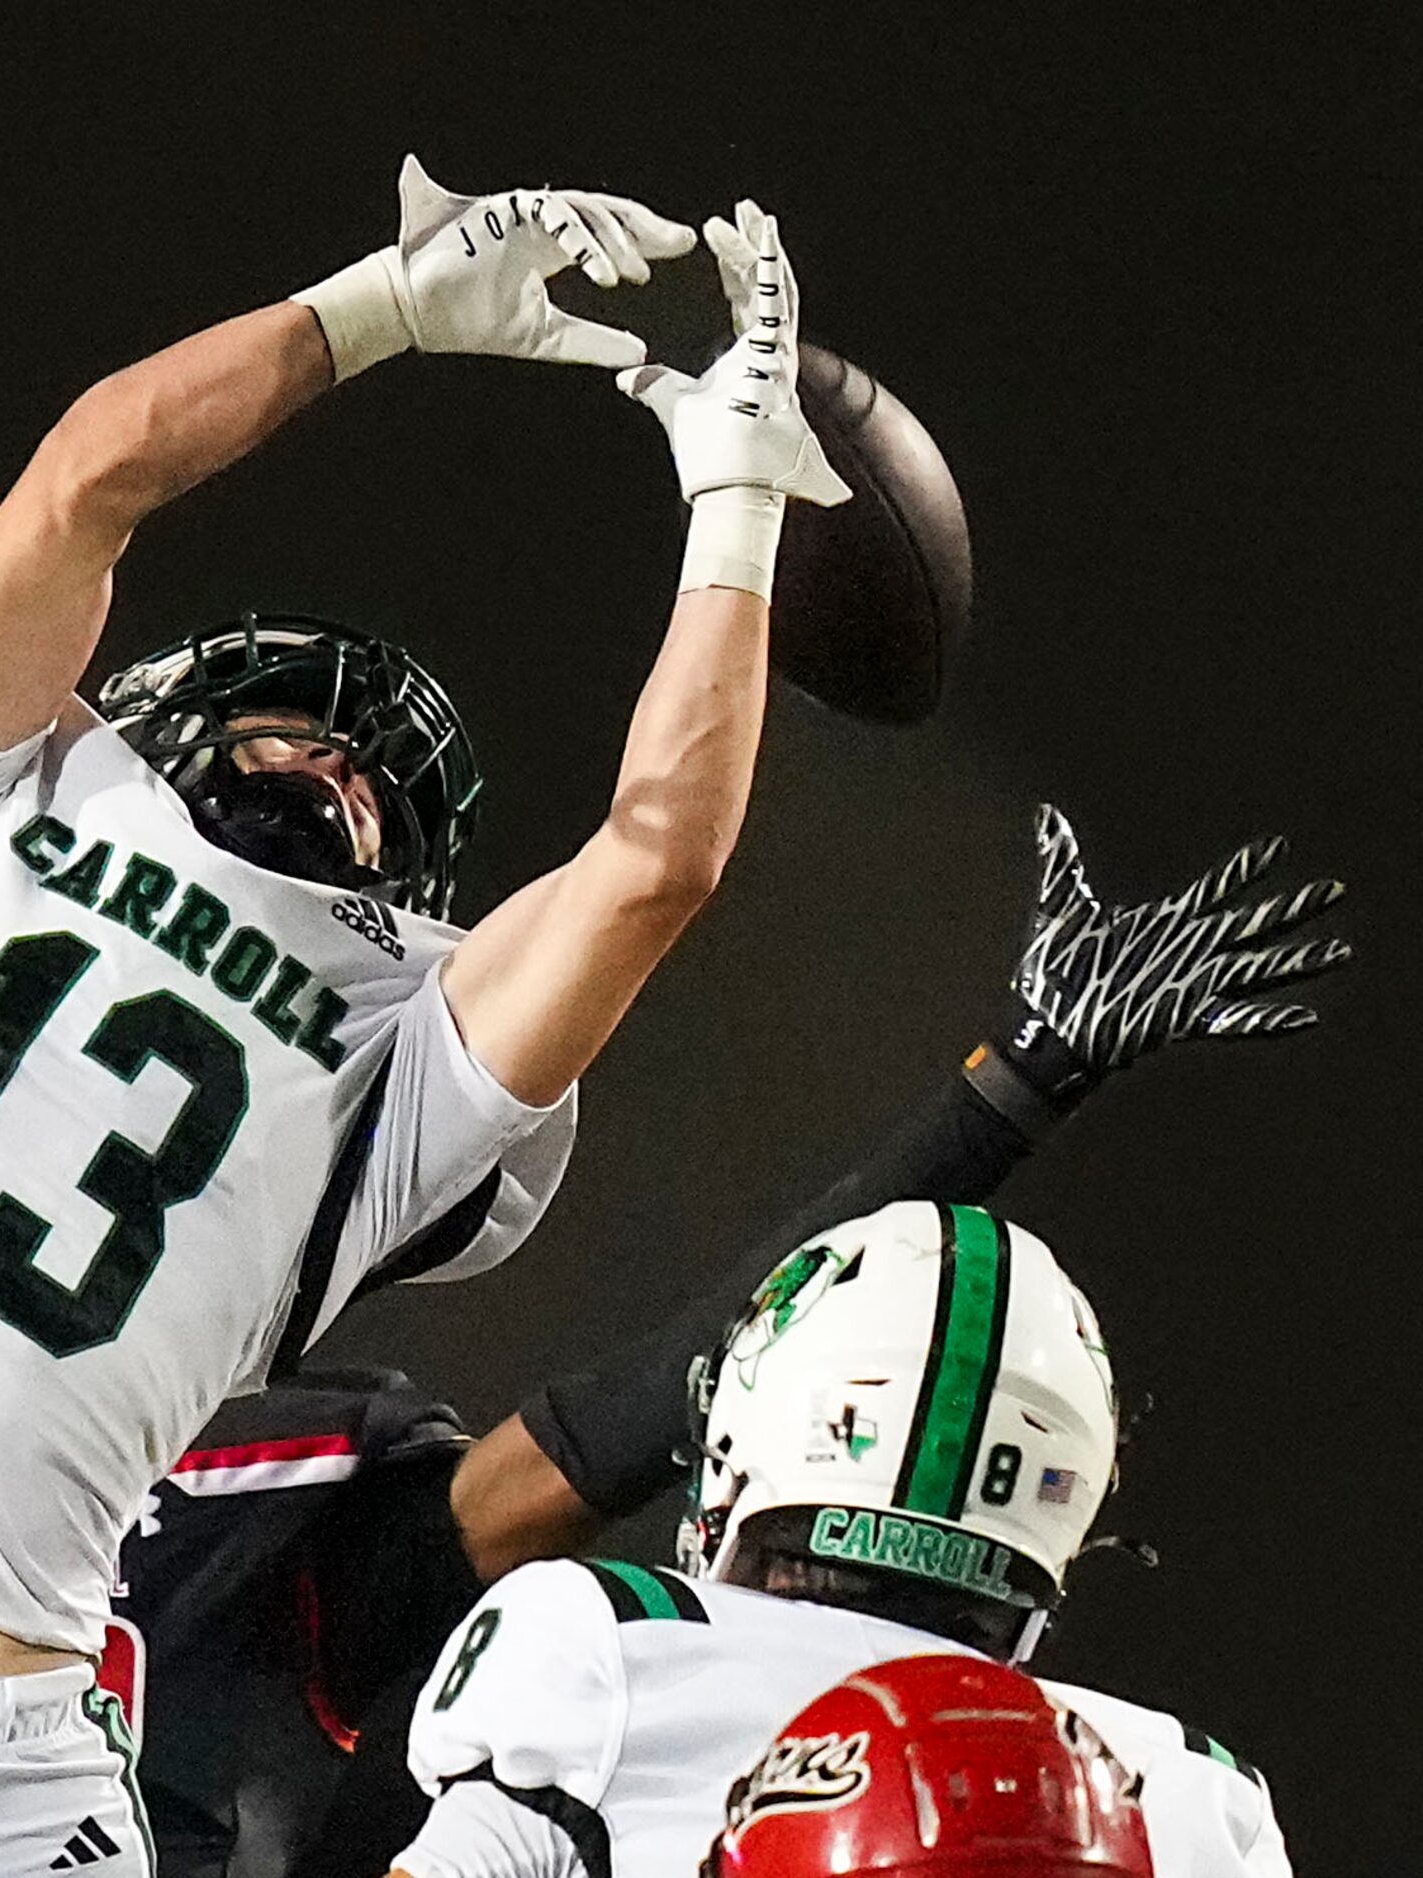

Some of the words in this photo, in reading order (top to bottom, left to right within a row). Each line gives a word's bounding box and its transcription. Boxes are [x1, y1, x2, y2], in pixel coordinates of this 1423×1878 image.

[10, 814, 350, 1074] CARROLL
[332, 903, 406, 961] adidas
[980, 1442, 1023, 1507] 8
[809, 1507, 1012, 1600] CARROLL
[433, 1608, 503, 1713] 8
